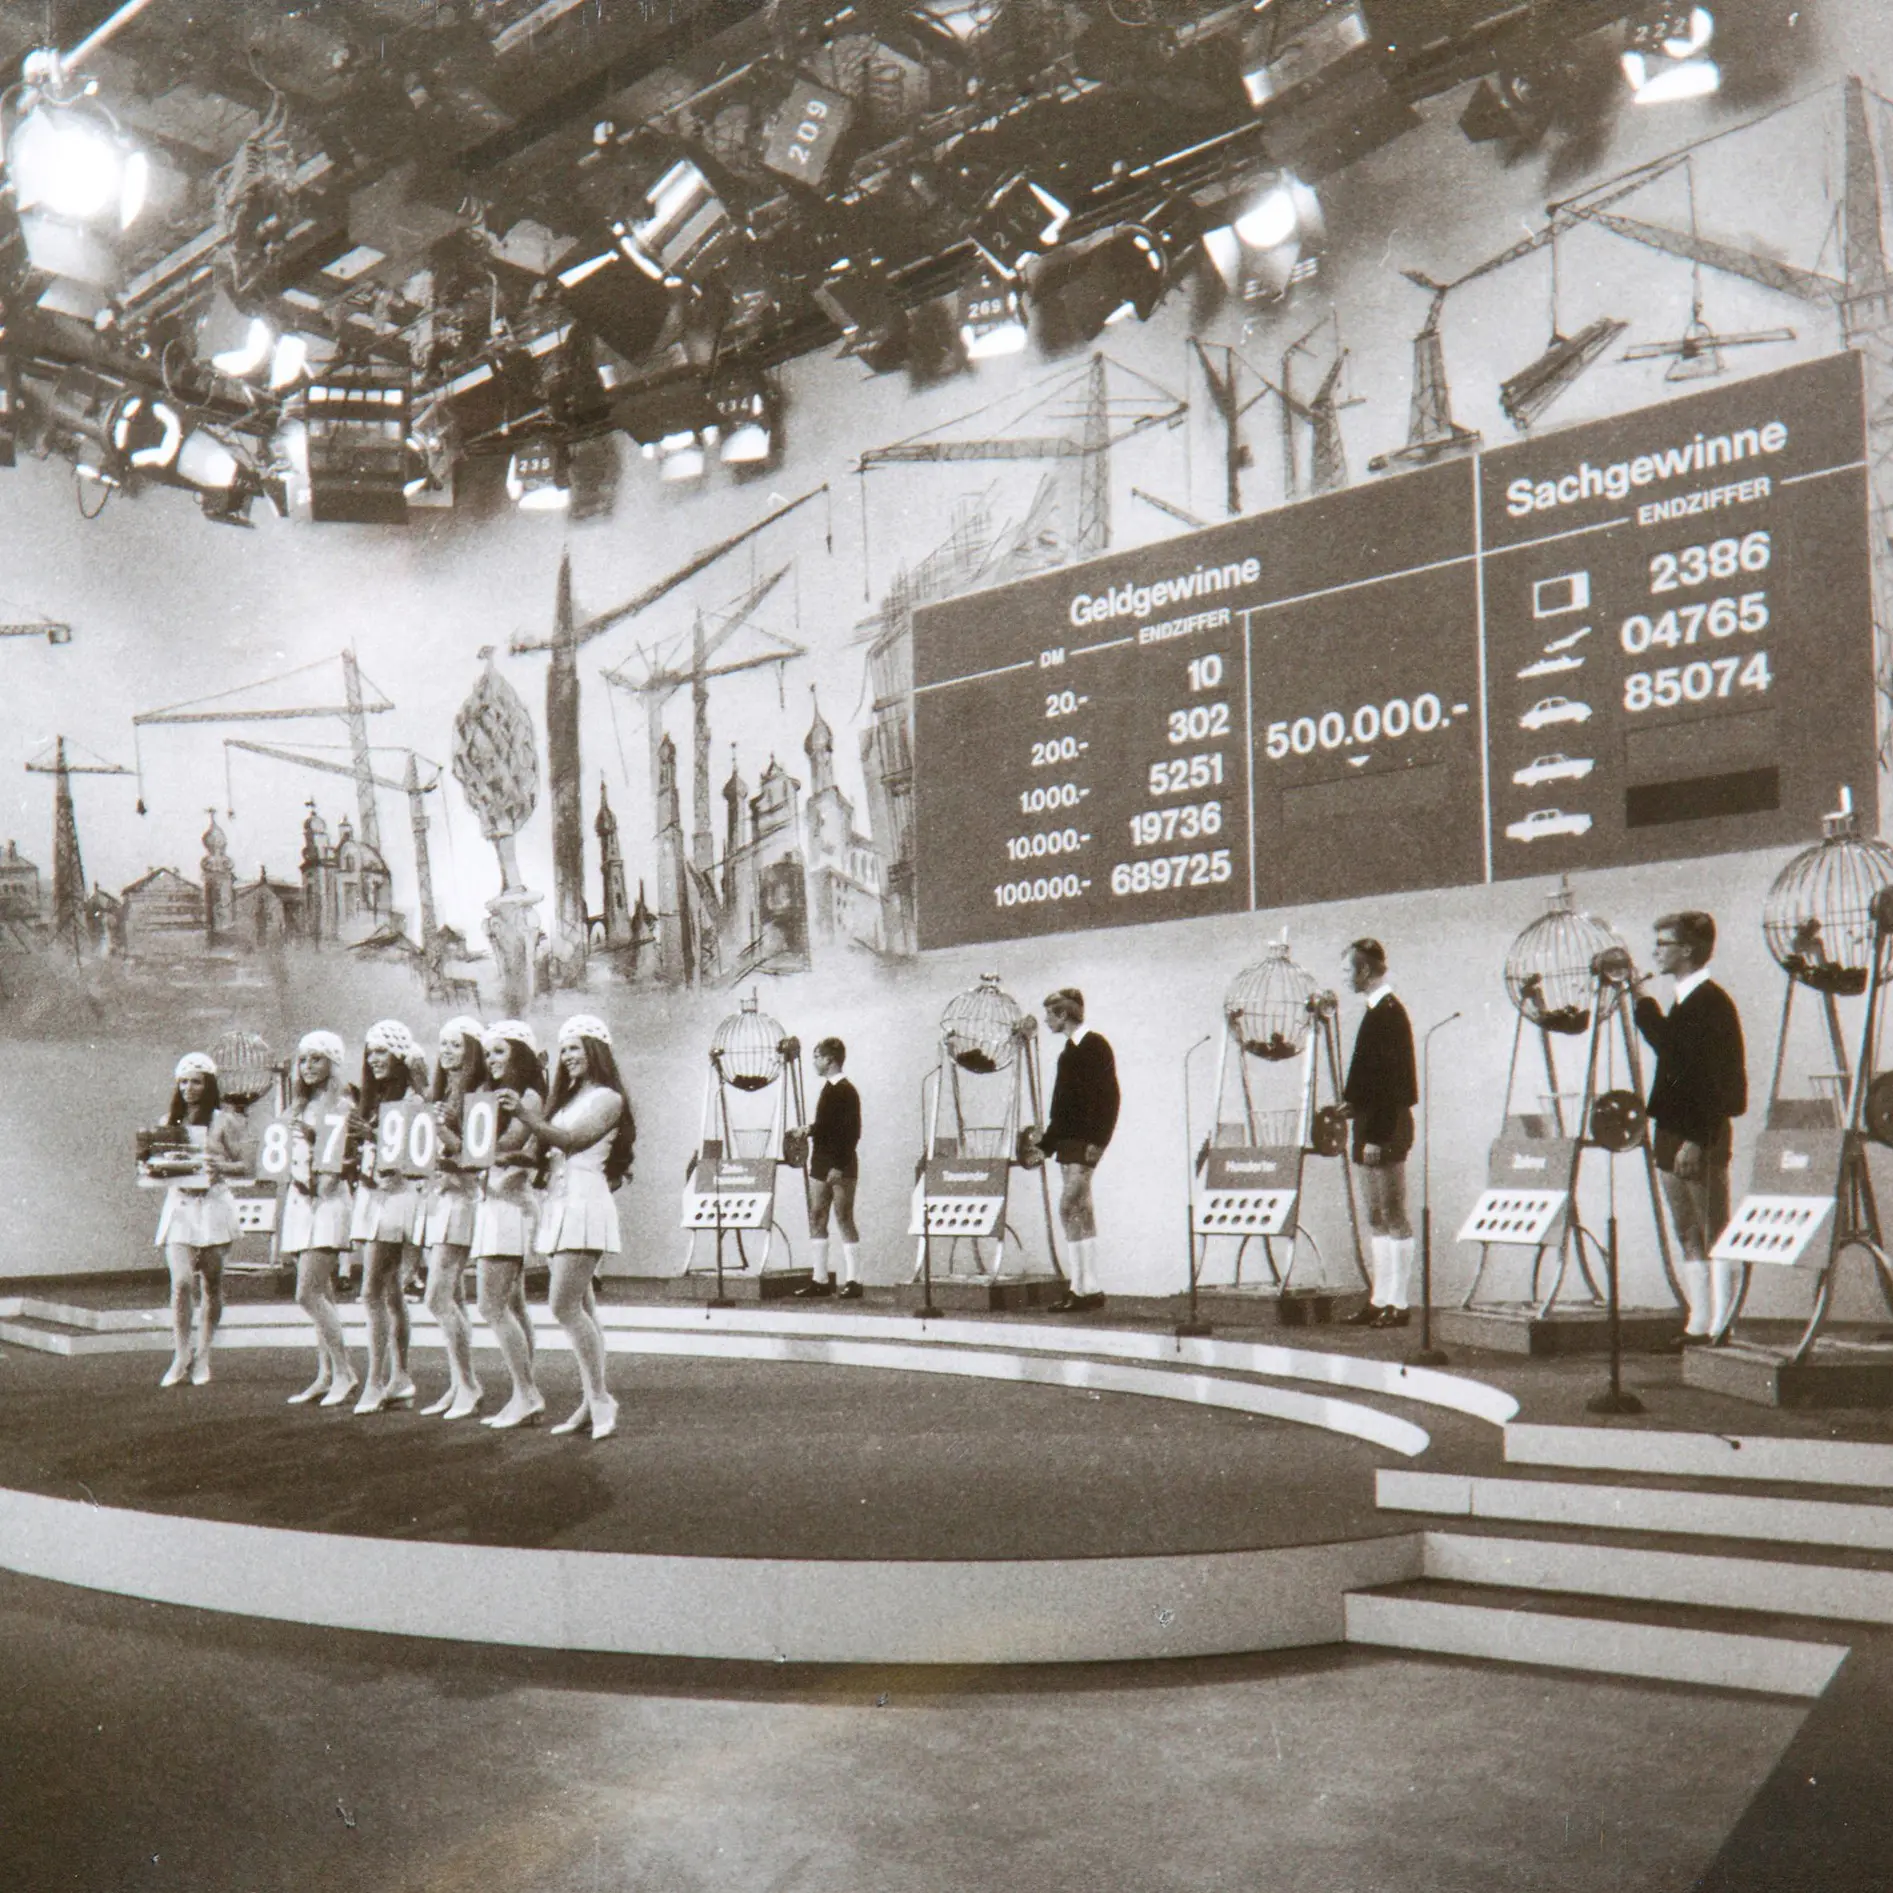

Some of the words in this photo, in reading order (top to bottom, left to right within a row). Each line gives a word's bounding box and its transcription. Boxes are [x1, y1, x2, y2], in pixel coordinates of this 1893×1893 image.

[787, 99, 828, 165] 209
[1507, 422, 1787, 516] Sachgewinne
[1638, 477, 1770, 525] ENDZIFFER
[1650, 532, 1770, 593] 2386
[1070, 559, 1260, 626] Geldgewinne
[1040, 648, 1065, 668] DM
[1138, 608, 1230, 645] ENDZIFFER
[1621, 592, 1768, 654] 04765
[1188, 655, 1222, 691] 10
[1624, 652, 1771, 711] 85074
[1168, 703, 1230, 744] 302
[1266, 693, 1468, 759] 500.000.-
[1150, 753, 1222, 796] 5251
[1130, 802, 1222, 846] 19736
[1111, 850, 1231, 895] 689725
